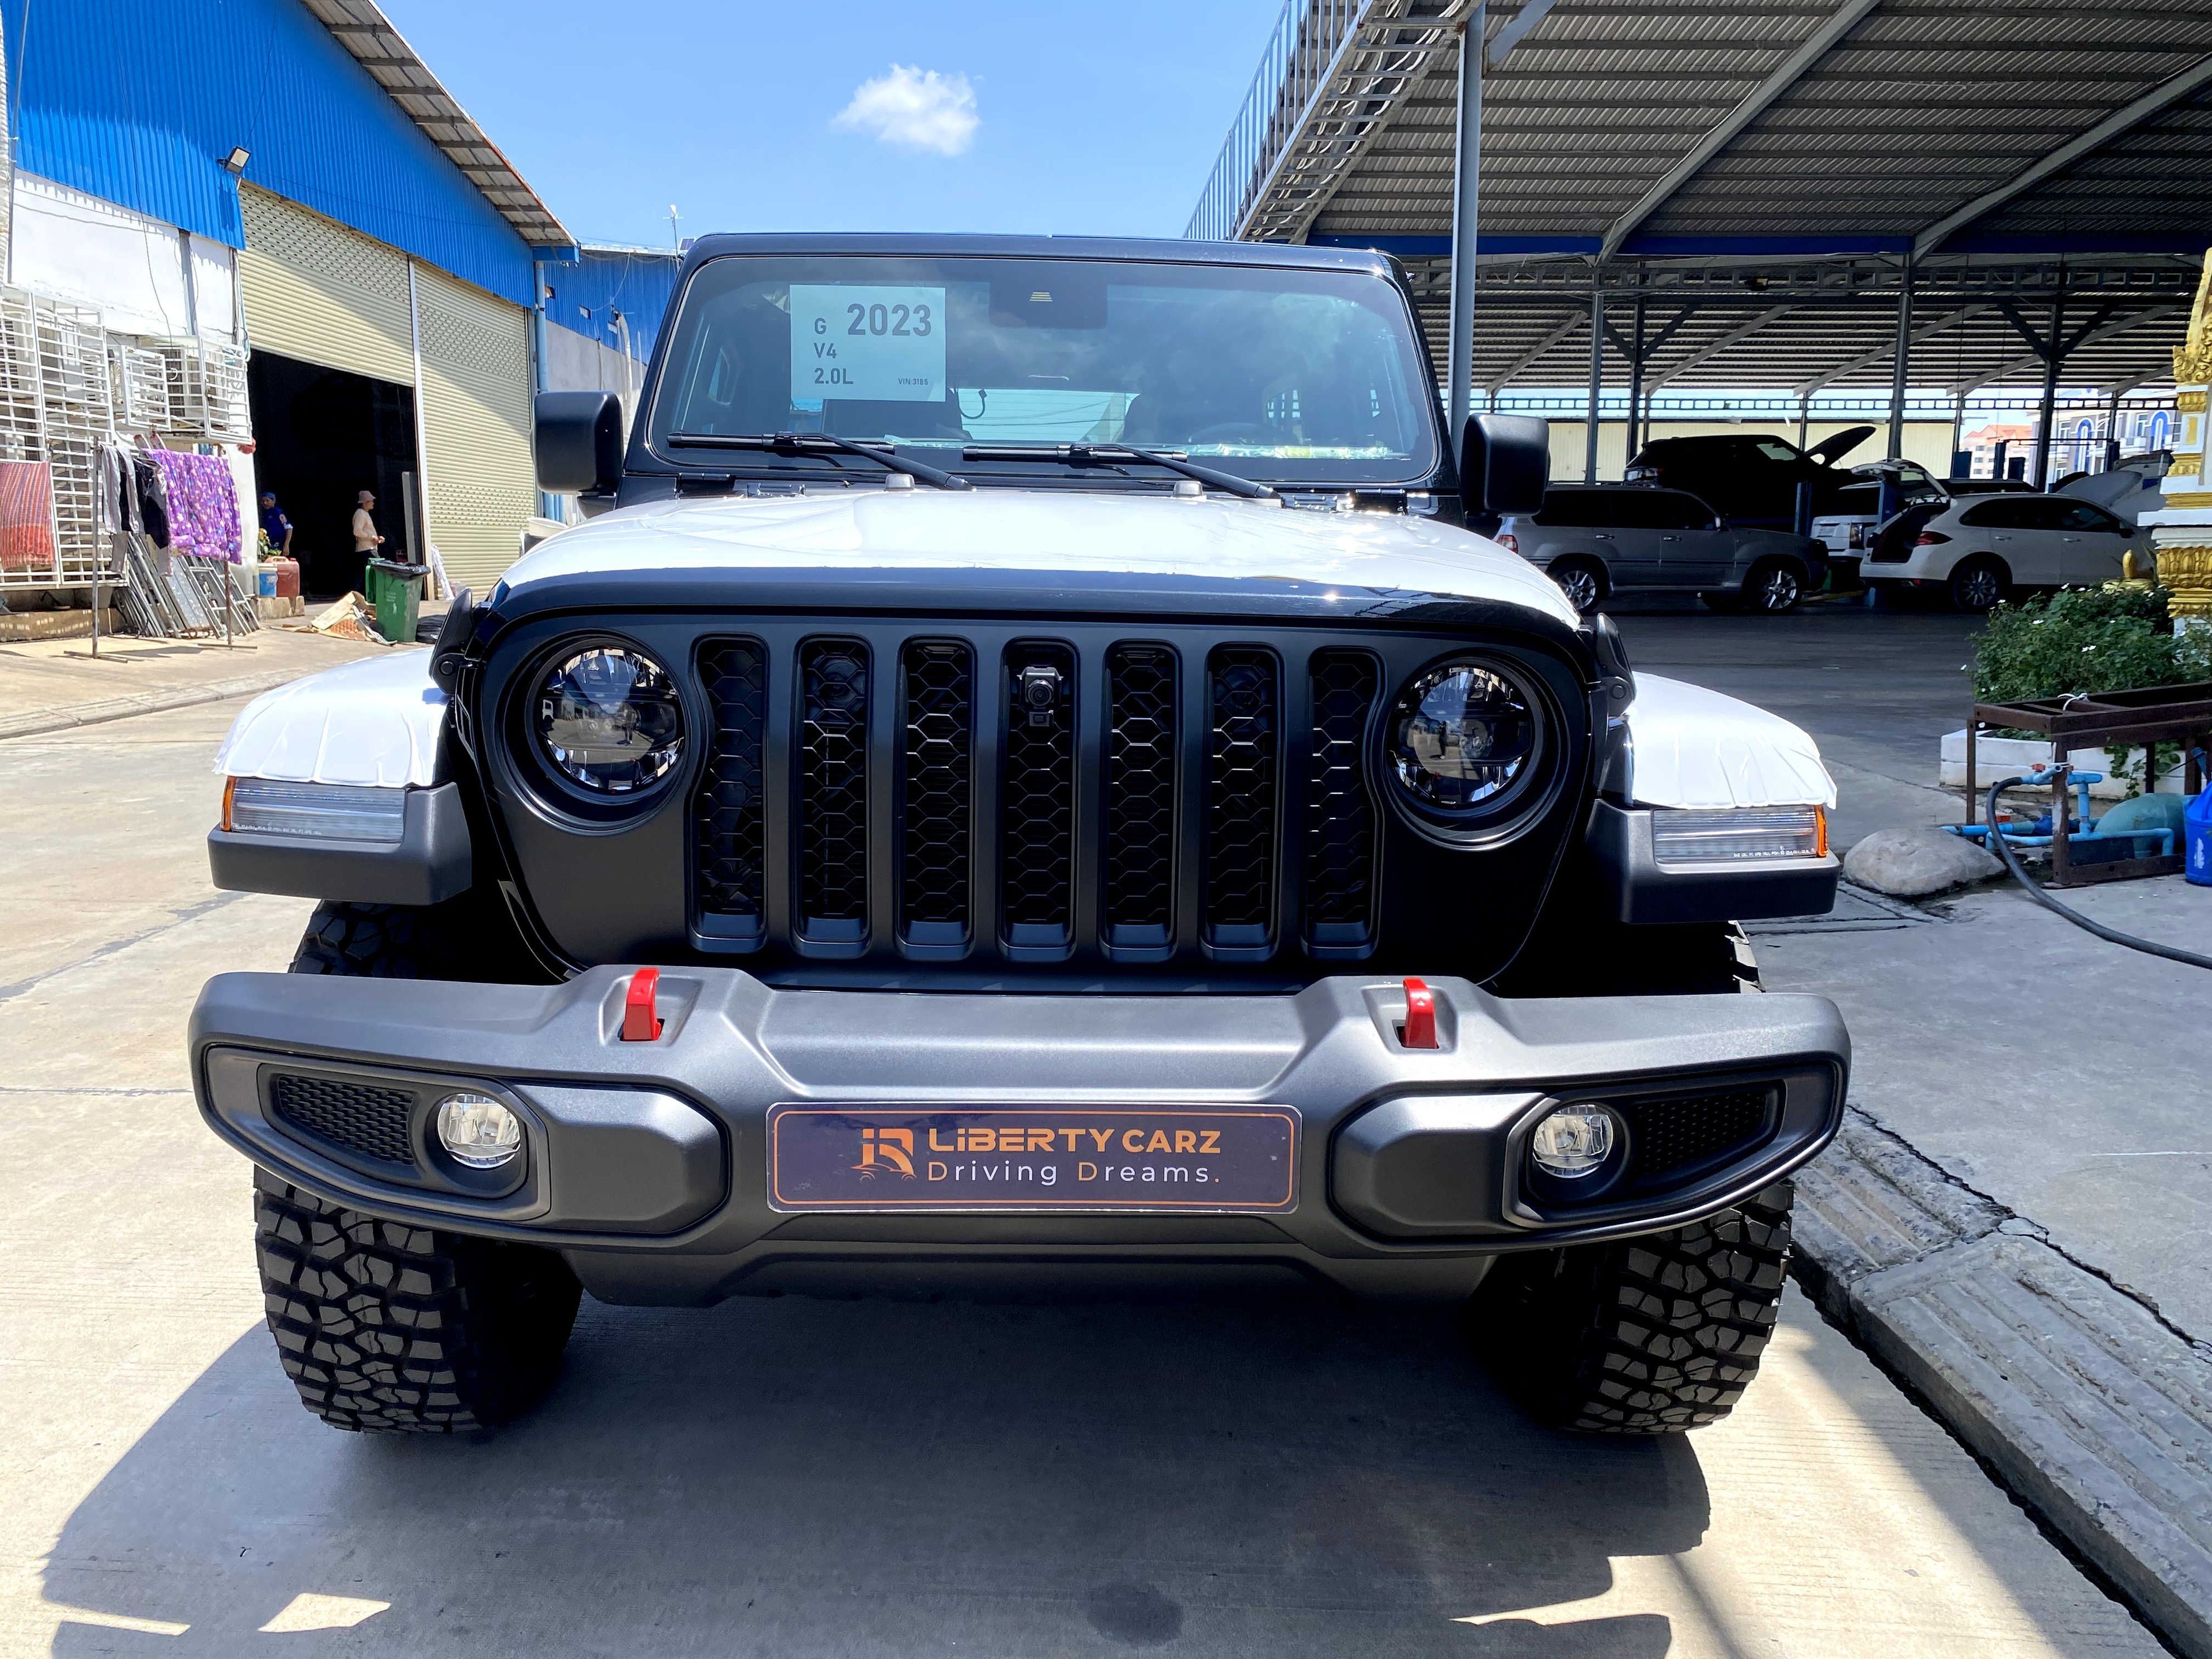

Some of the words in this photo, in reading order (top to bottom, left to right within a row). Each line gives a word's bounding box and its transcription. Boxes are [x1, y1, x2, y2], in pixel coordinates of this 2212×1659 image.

[814, 317, 827, 335] G
[847, 303, 932, 336] 2023
[813, 342, 837, 359] V4
[814, 367, 854, 385] 2.0L
[1122, 1128, 1221, 1154] CARZ
[927, 1160, 1058, 1186] Driving
[1077, 1161, 1220, 1183] Dreams.
